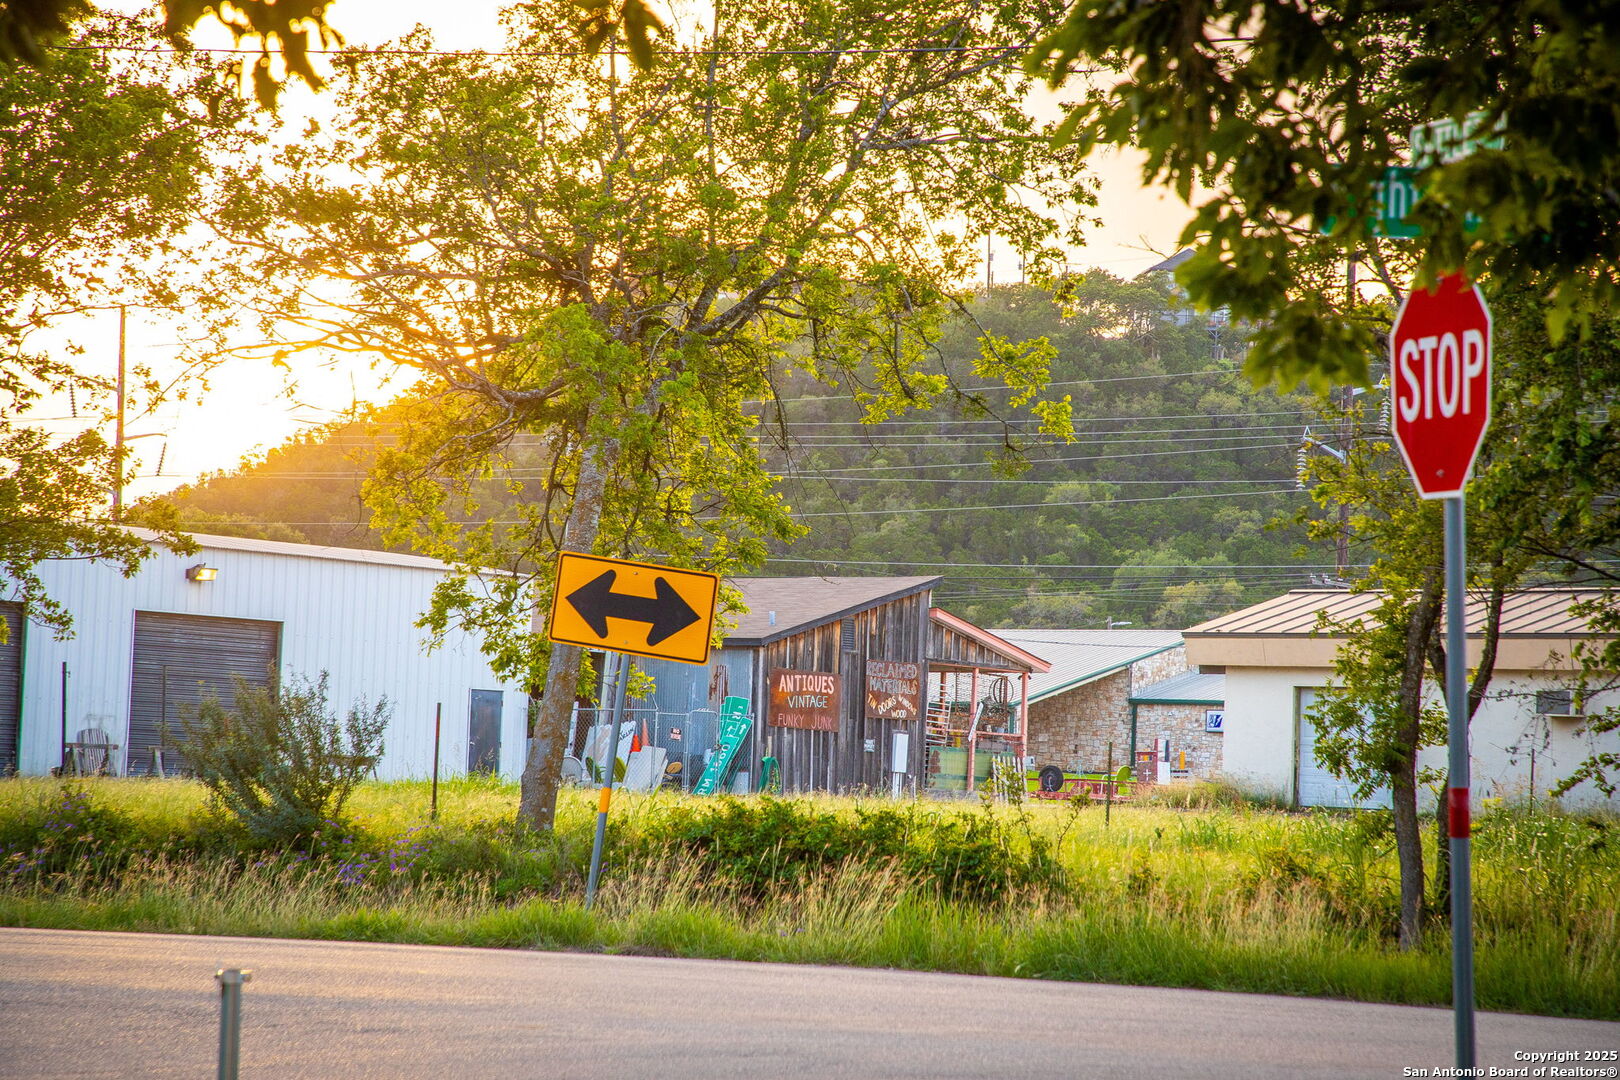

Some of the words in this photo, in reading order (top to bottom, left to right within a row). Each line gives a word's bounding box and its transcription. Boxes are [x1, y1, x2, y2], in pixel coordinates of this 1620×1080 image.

[1399, 329, 1485, 423] STOP
[866, 661, 917, 679] RECLAIMED
[779, 674, 835, 694] ANTIQUES
[869, 676, 918, 696] MATERIALS
[787, 695, 829, 709] VINTAGE
[867, 693, 878, 710] TIN
[877, 695, 897, 715] DOORS
[778, 713, 804, 728] FUNKY
[811, 716, 833, 730] JUNK
[890, 709, 907, 719] WOOD
